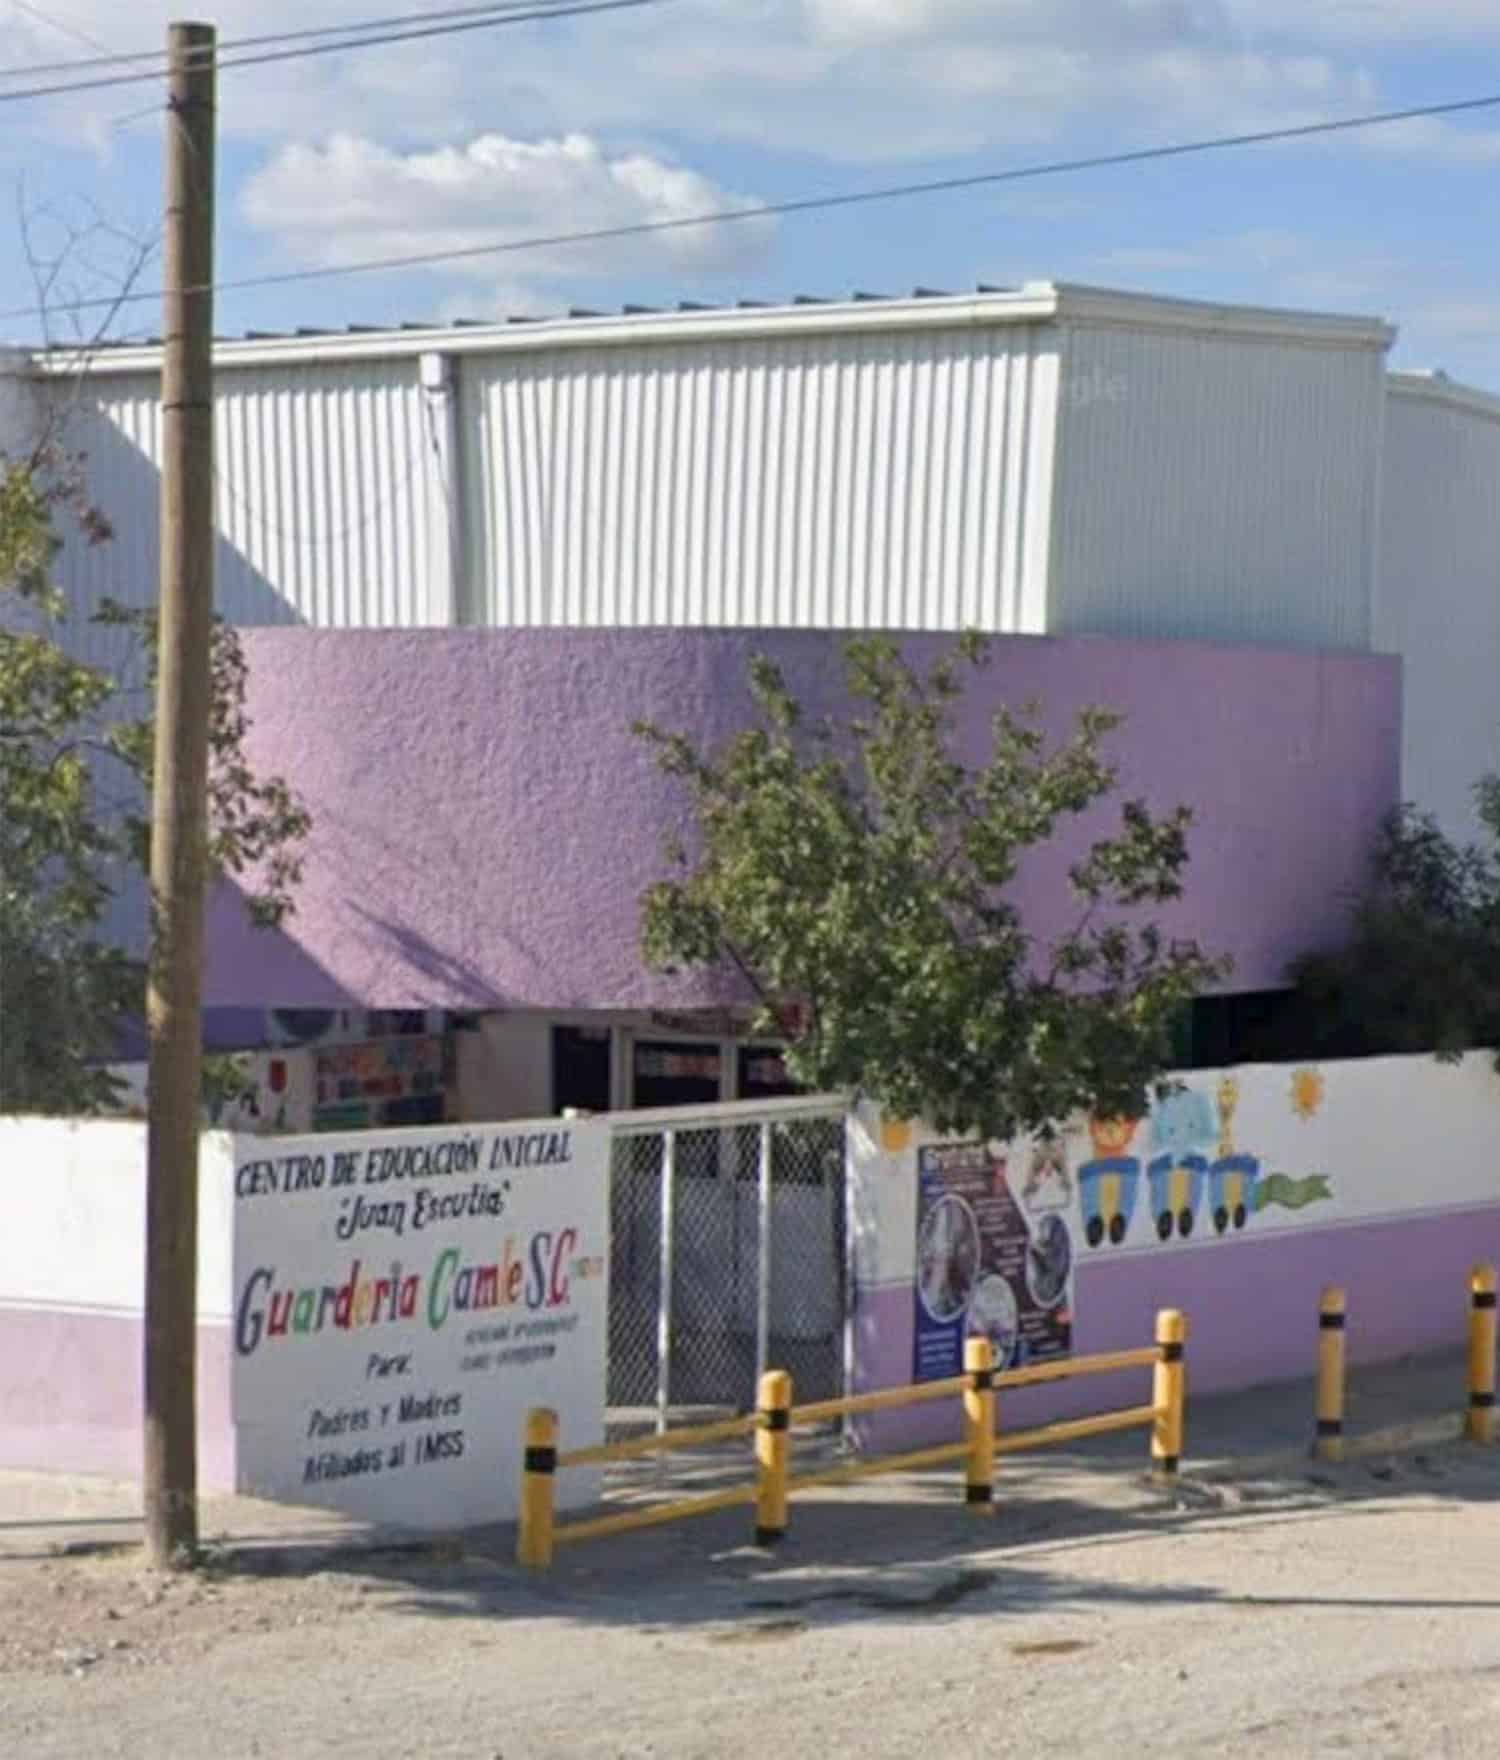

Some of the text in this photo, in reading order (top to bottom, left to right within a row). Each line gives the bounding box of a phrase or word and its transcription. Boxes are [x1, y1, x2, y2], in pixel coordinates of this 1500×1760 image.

[236, 1130, 572, 1199] CENTRO DE EDUCACIÓN INICIAL
[428, 1236, 522, 1331] Camle
[306, 1405, 369, 1438] Padres
[399, 1391, 462, 1423] Madres
[414, 1428, 464, 1464] IMSS
